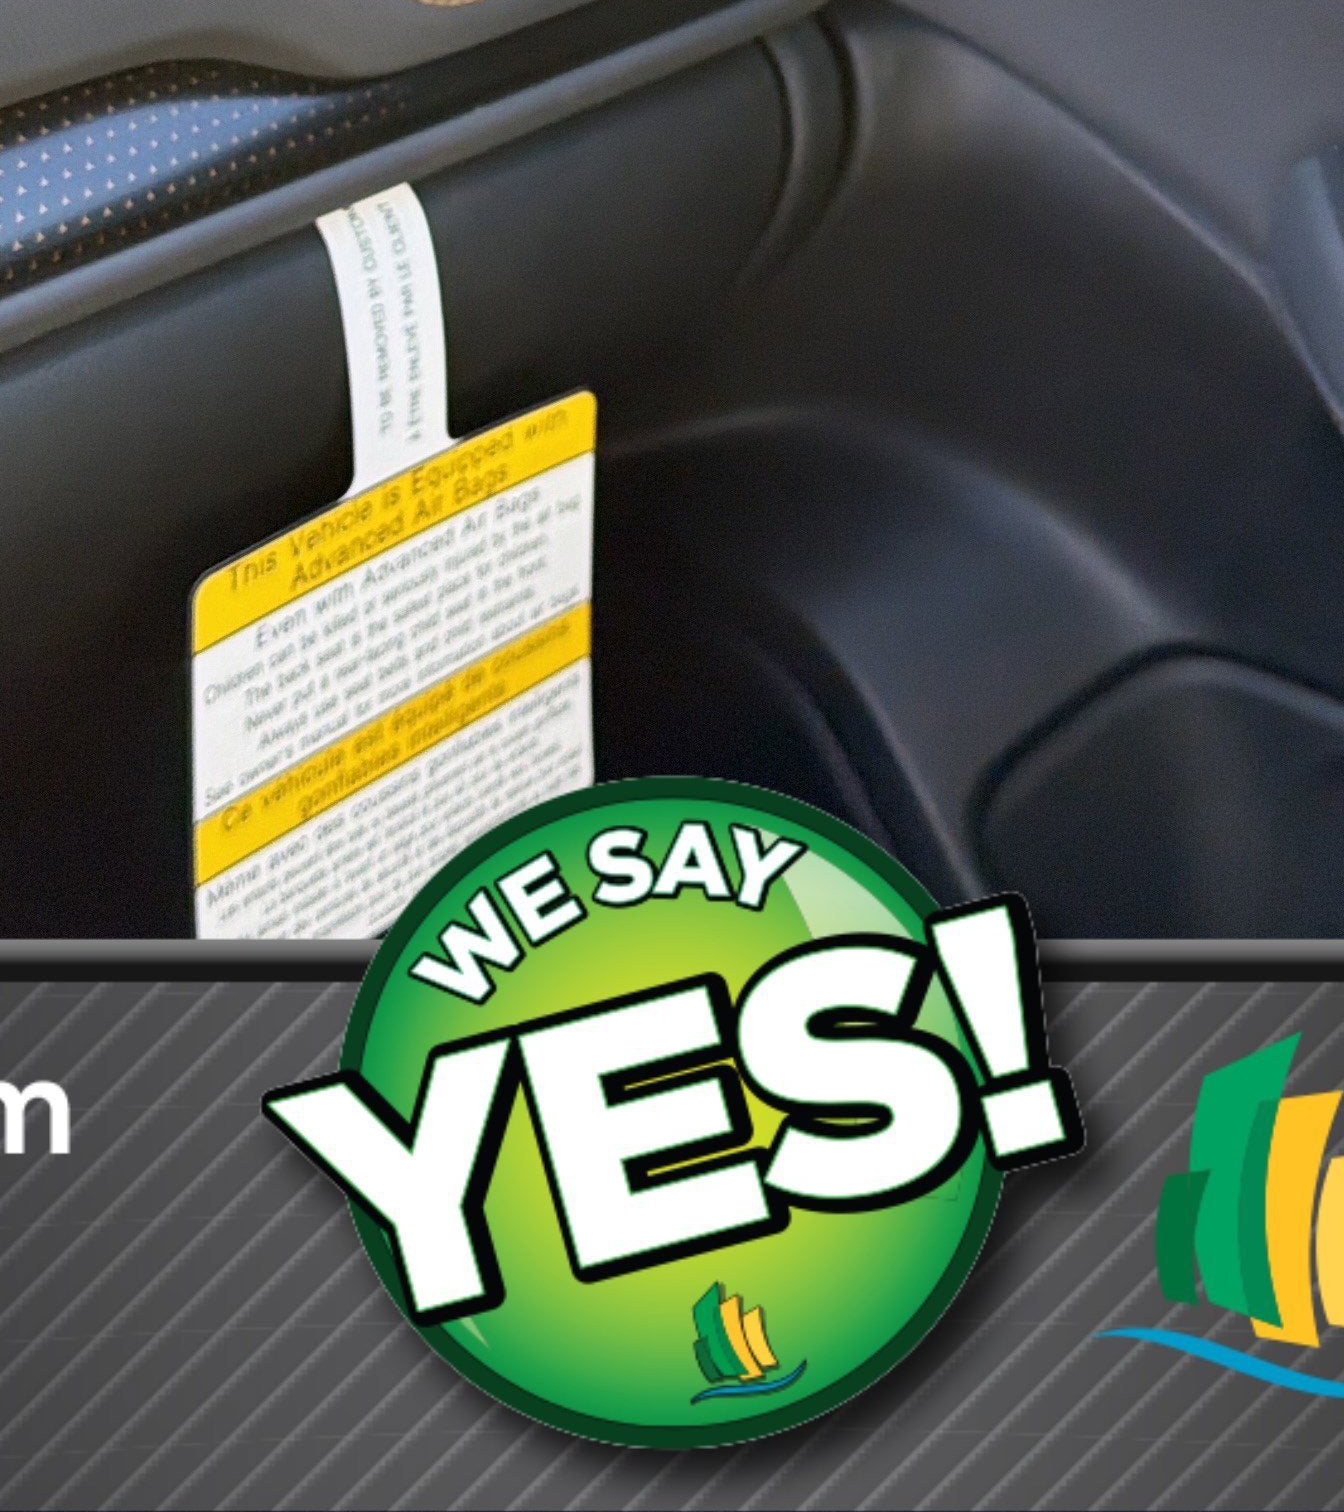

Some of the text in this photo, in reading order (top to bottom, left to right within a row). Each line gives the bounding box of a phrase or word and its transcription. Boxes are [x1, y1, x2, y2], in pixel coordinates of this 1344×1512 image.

[369, 302, 390, 379] REMOVED
[230, 548, 278, 591] This
[289, 498, 372, 556] Vehicle
[411, 426, 512, 495] Equipped
[524, 404, 568, 441] with
[255, 484, 540, 648] Even with Advanced Air Bags
[289, 460, 507, 591] Advanced Air Bags
